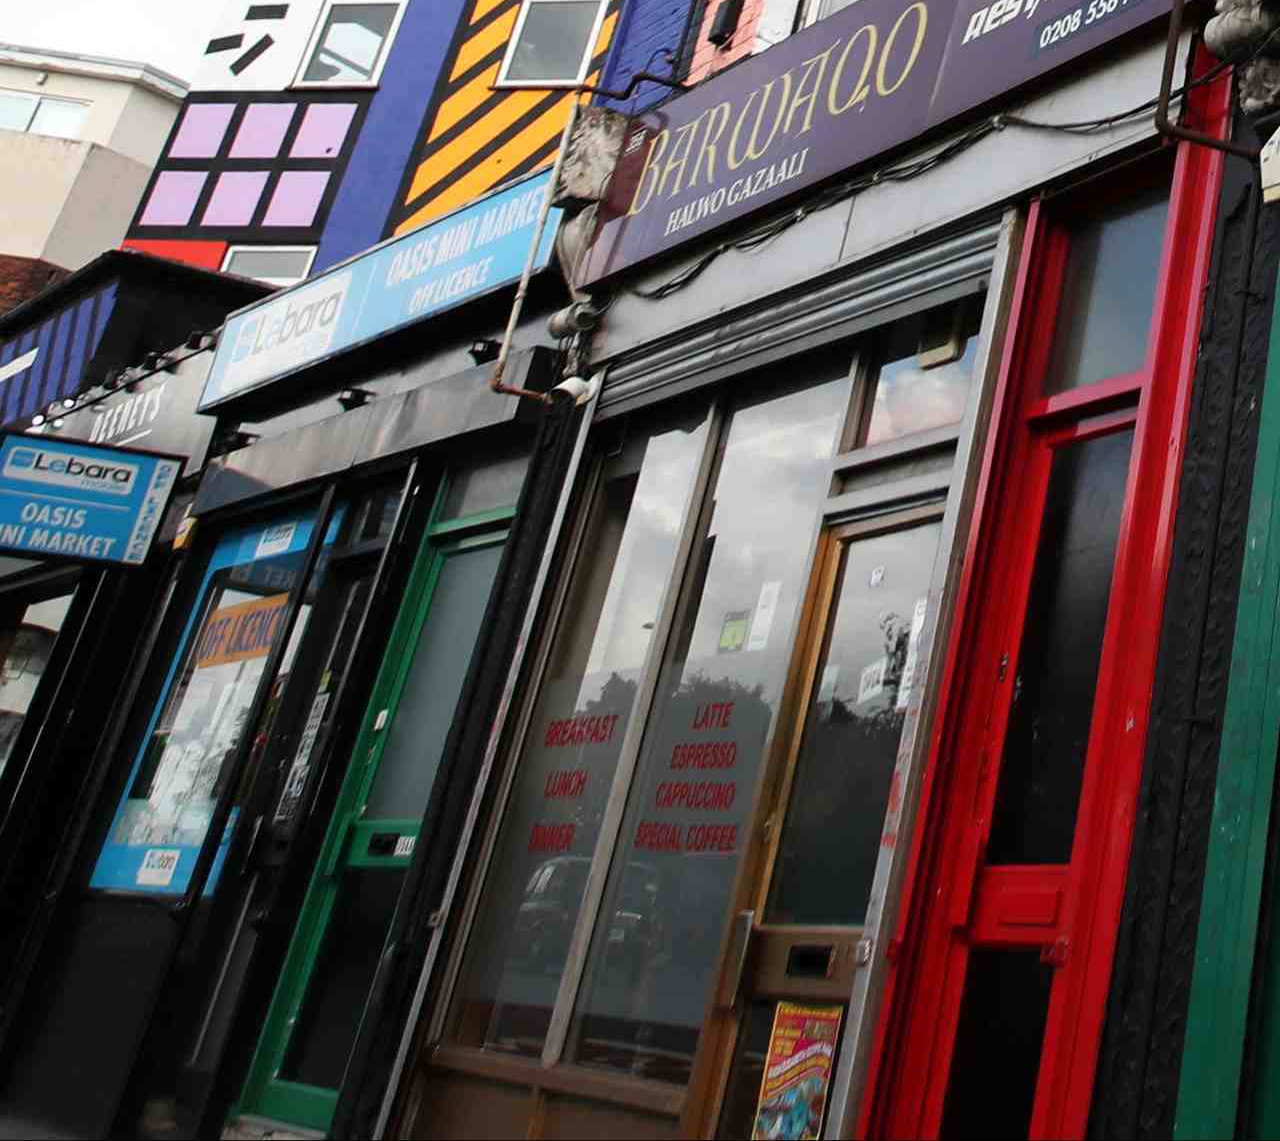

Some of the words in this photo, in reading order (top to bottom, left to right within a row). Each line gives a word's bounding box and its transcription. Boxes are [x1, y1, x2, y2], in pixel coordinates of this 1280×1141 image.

[1039, 9, 1082, 49] 0208
[627, 1, 929, 217] BARWAQO
[664, 187, 728, 237] HALWO
[725, 147, 810, 207] GAZAALI
[33, 452, 132, 483] Lebara
[20, 502, 88, 529] OASIS
[29, 527, 118, 558] MARKET
[543, 714, 620, 748] BREAKFAST
[689, 701, 735, 732] LATTE
[670, 740, 737, 770] ESPRESSO
[543, 769, 588, 799] LUNCH
[655, 780, 737, 810] CAPPUCCINO
[527, 821, 577, 852] DINNER
[632, 820, 684, 851] SPECIAL
[686, 822, 738, 854] COFFEE
